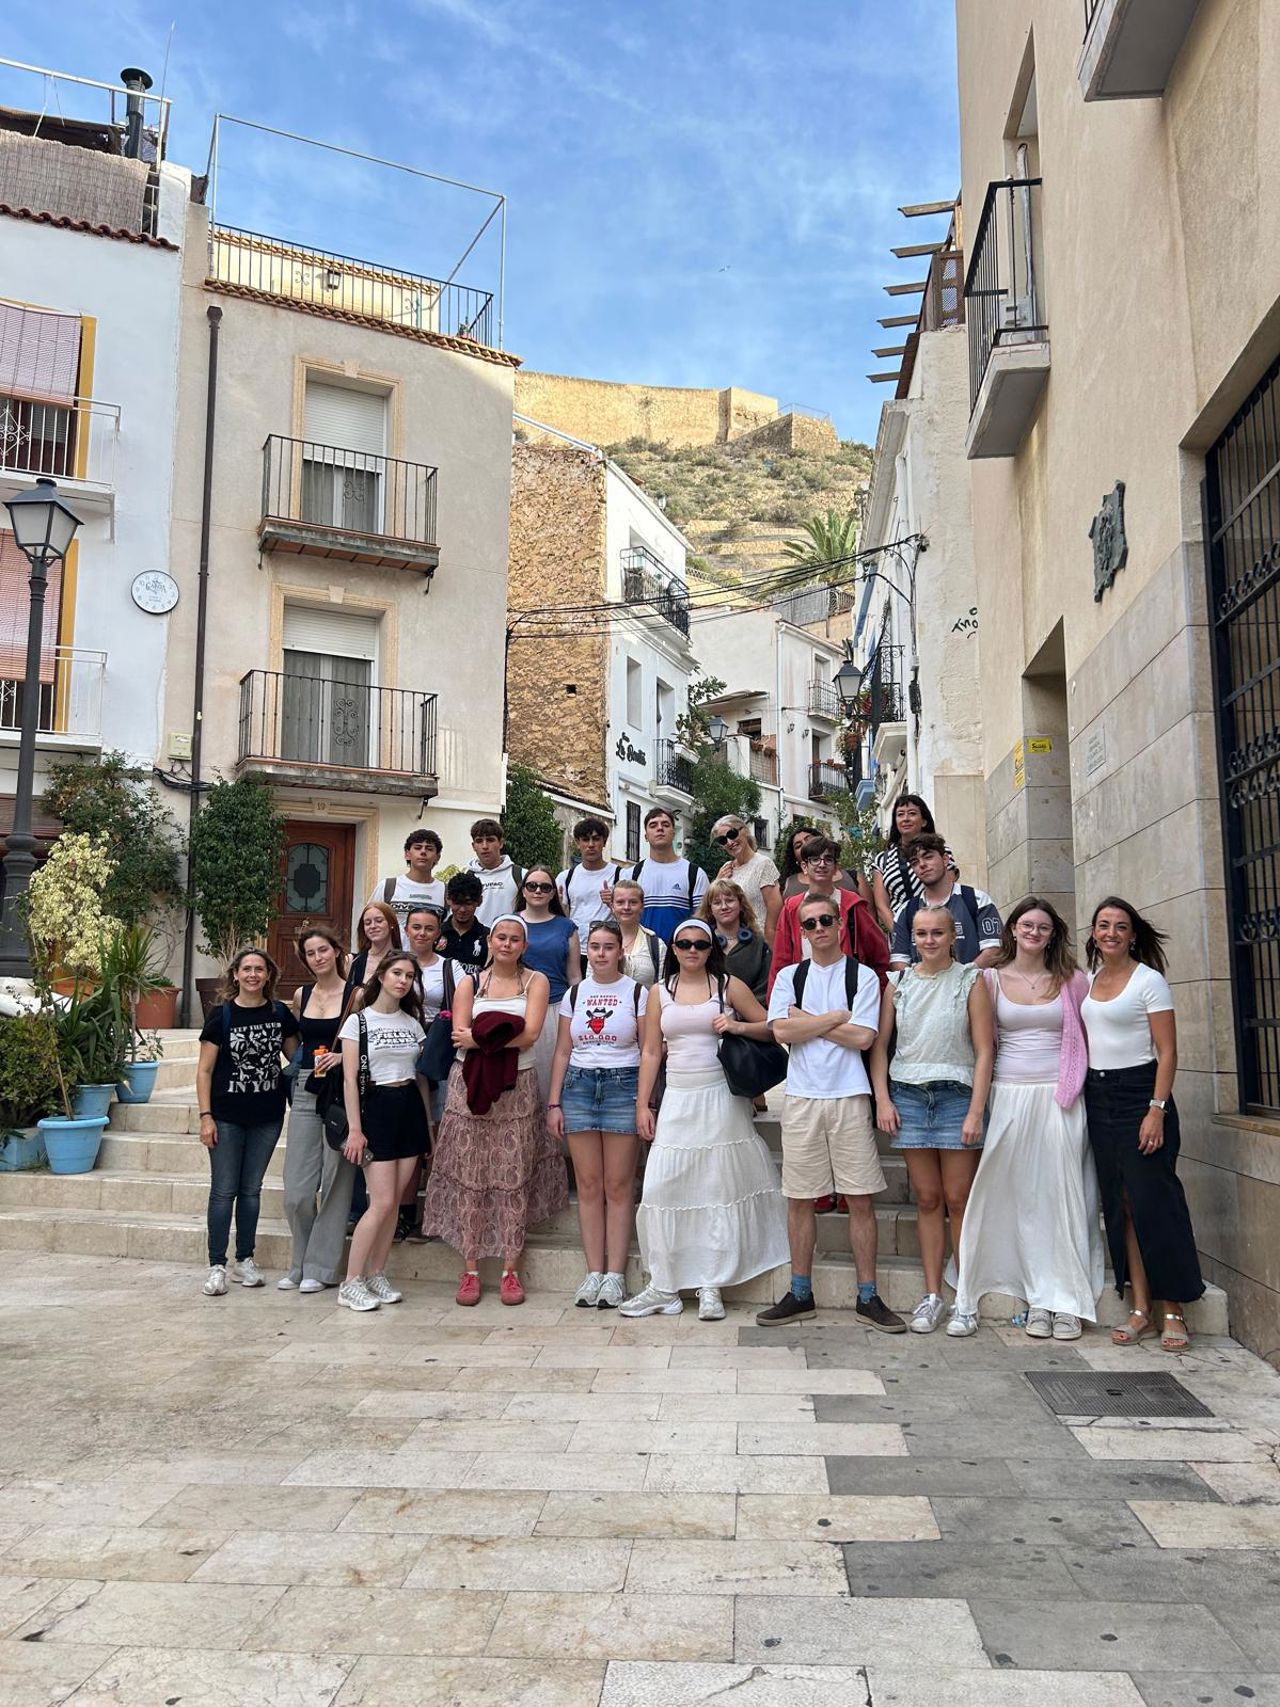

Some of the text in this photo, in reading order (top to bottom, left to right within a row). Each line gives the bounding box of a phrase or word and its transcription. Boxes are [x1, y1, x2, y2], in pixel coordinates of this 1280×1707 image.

[459, 961, 482, 975] ORK
[586, 998, 618, 1006] WANTED
[227, 1080, 279, 1093] IN YOU
